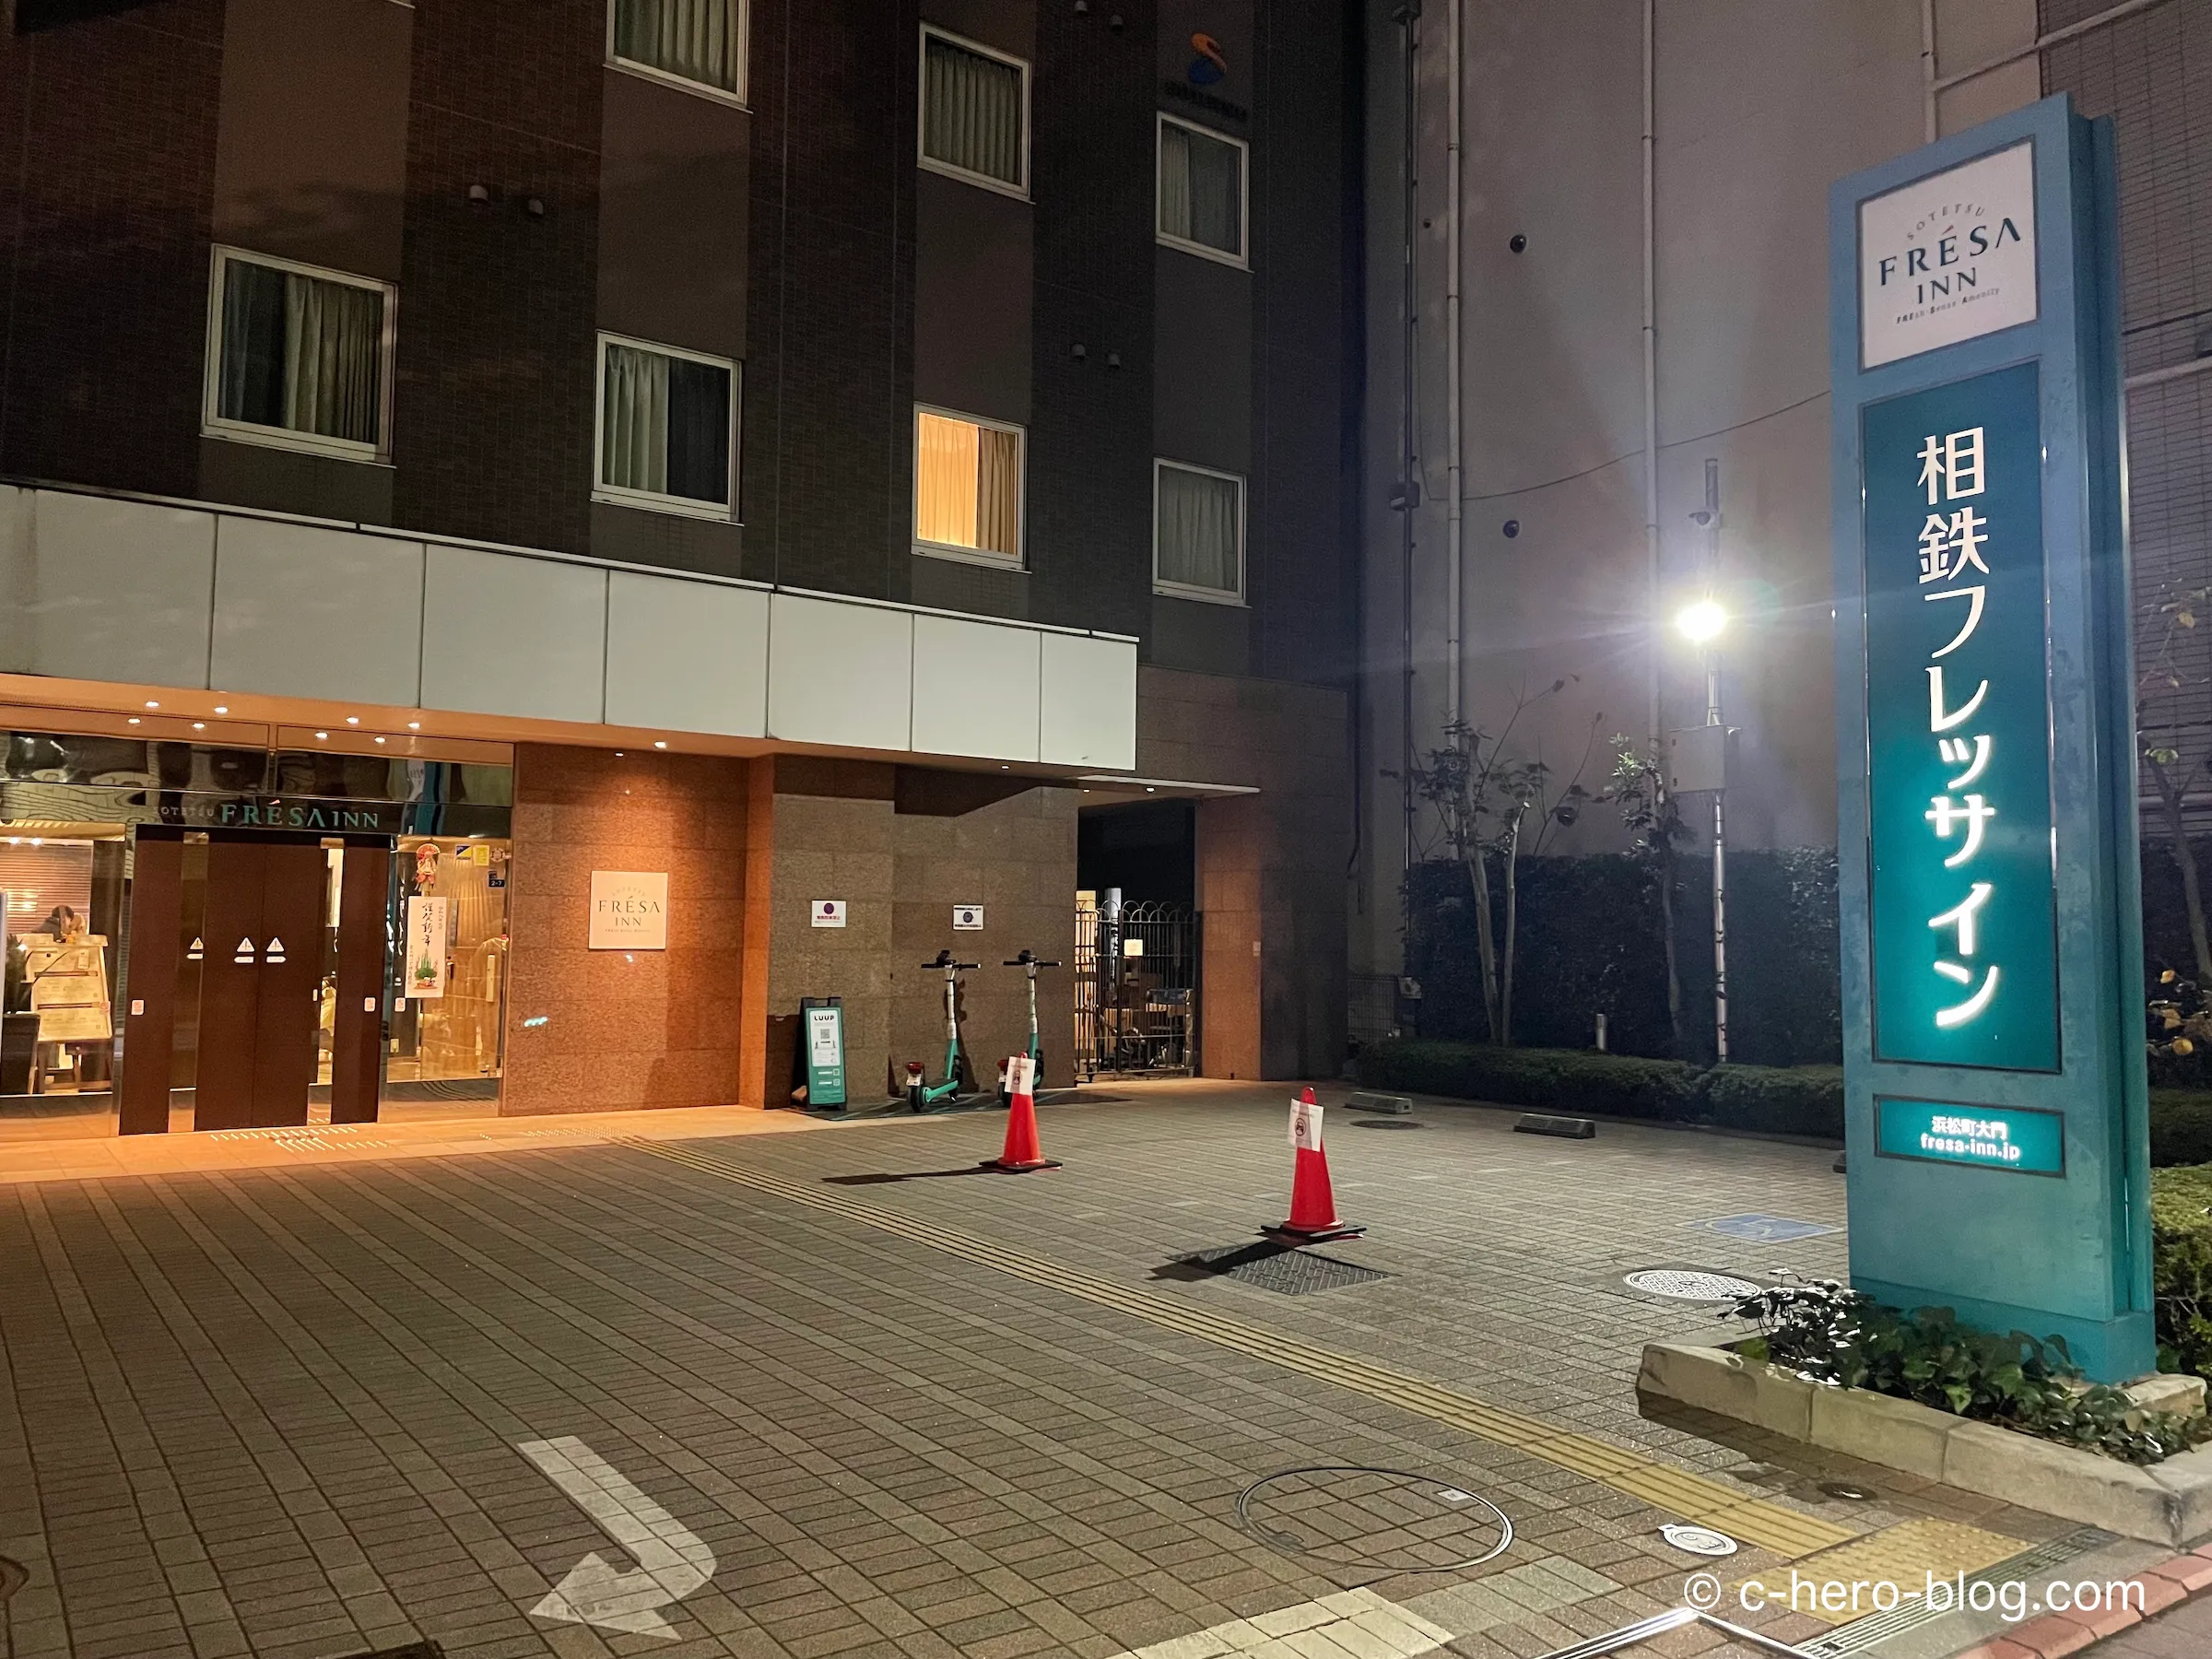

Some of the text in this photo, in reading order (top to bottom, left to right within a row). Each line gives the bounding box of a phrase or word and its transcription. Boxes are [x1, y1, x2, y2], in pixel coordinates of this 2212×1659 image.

[1906, 203, 1985, 241] SOTETSU
[1878, 218, 2021, 286] FRÉSA
[1917, 267, 1977, 304] INN
[1917, 426, 1999, 1028] 相鉄フレッサイン
[333, 811, 379, 828] INN
[598, 895, 660, 913] FRÉSA
[615, 917, 641, 926] INN
[1931, 1115, 2007, 1141] 浜松町大門
[1920, 1132, 2021, 1161] fresa-inn.jp
